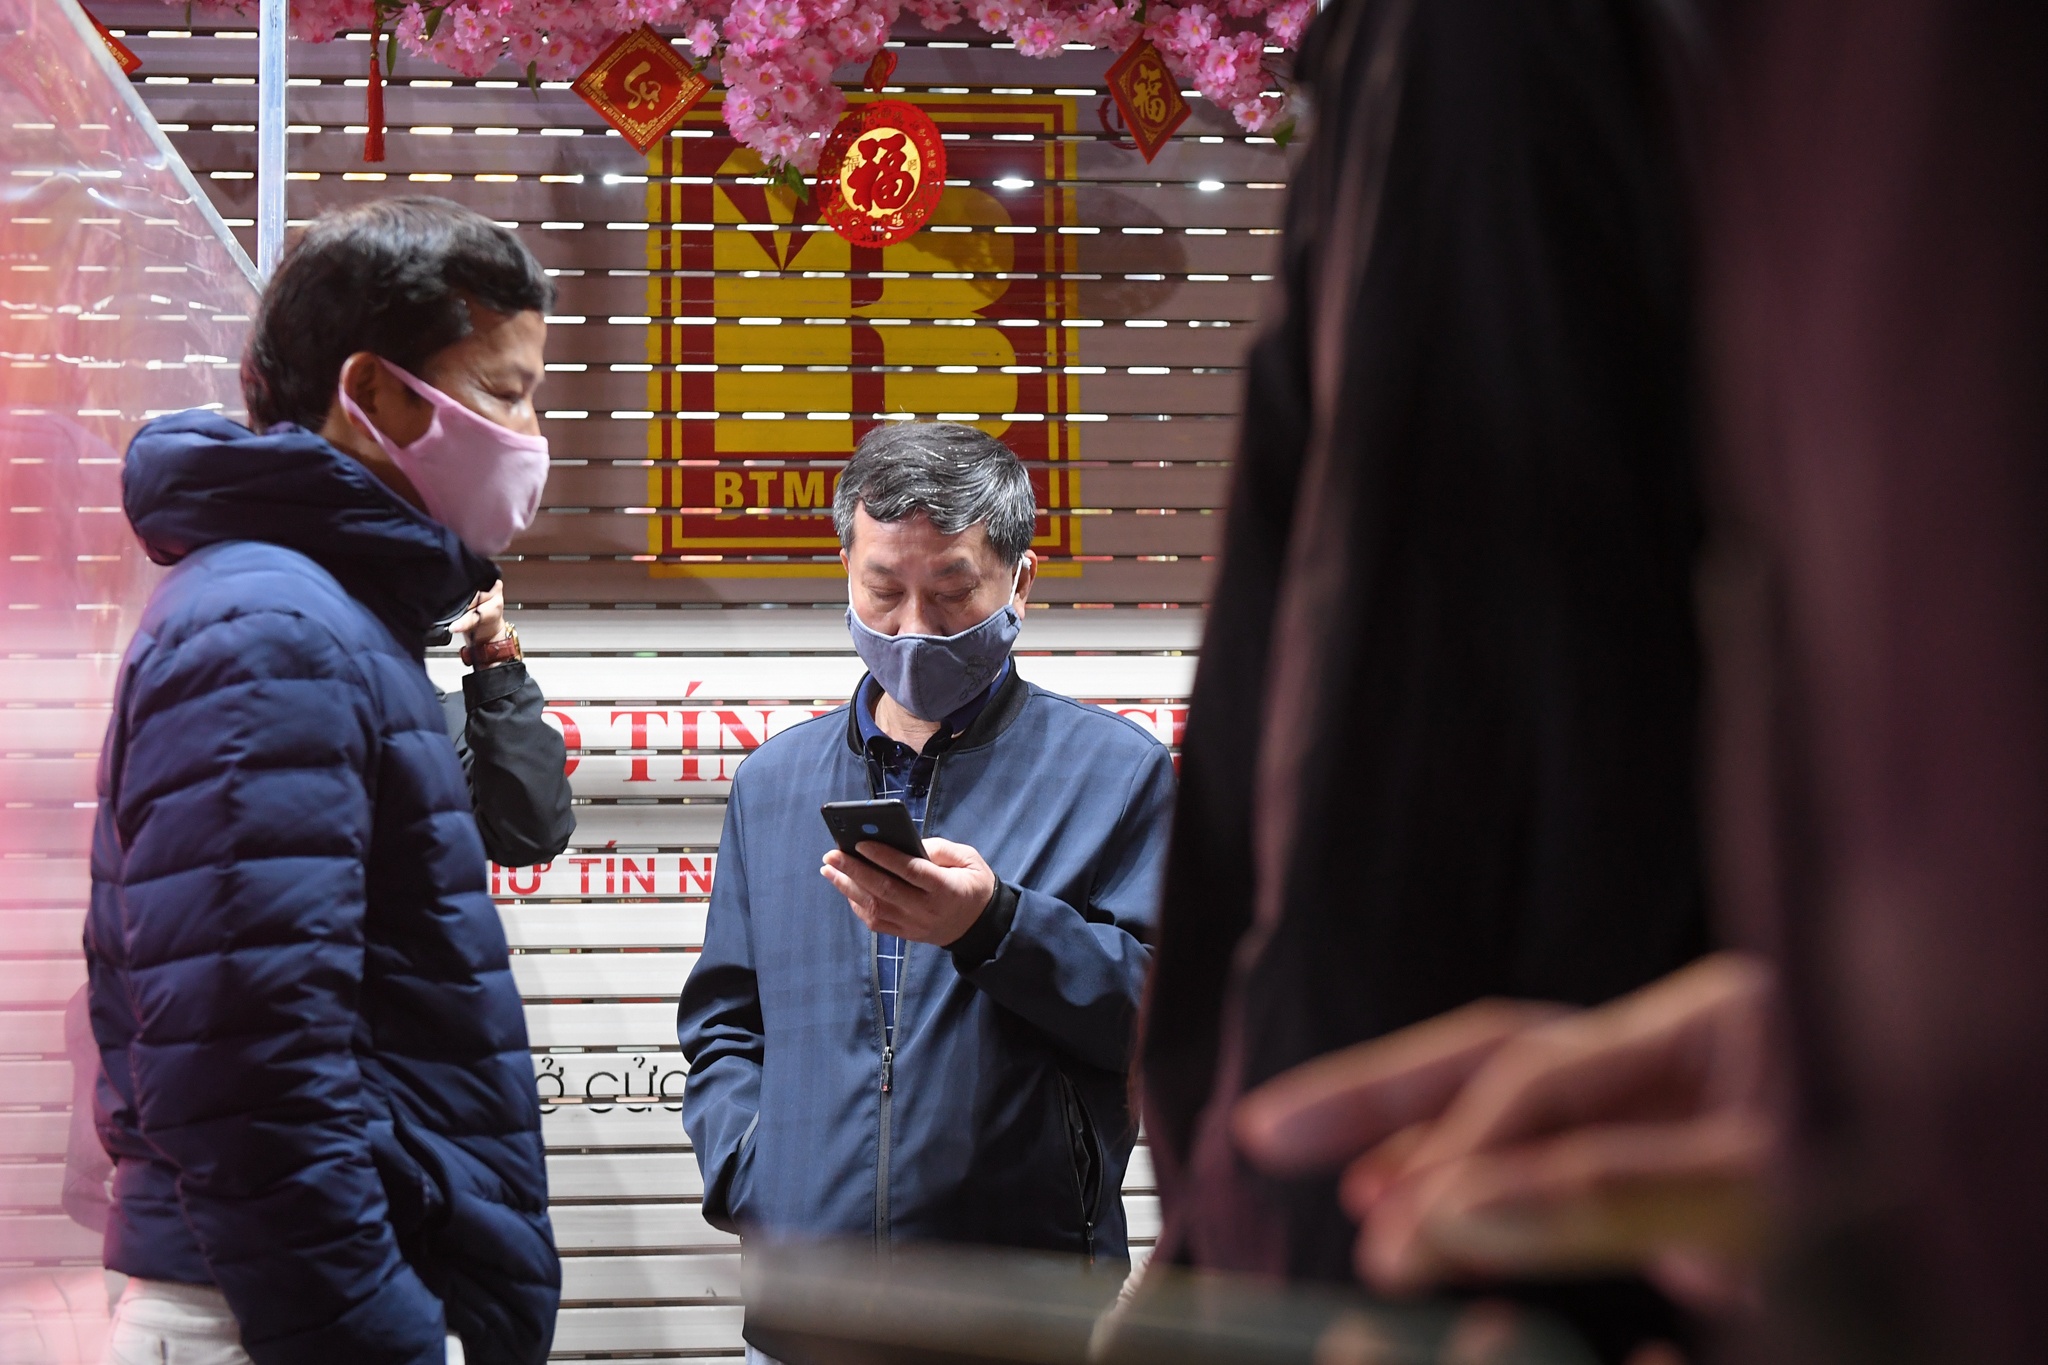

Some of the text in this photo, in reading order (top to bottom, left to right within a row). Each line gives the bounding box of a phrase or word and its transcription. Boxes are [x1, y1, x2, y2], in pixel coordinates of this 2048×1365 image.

[1133, 63, 1167, 123] 福
[846, 132, 916, 213] 福
[714, 471, 843, 521] BTM
[610, 681, 776, 782] TÍN
[568, 840, 655, 894] TÍN
